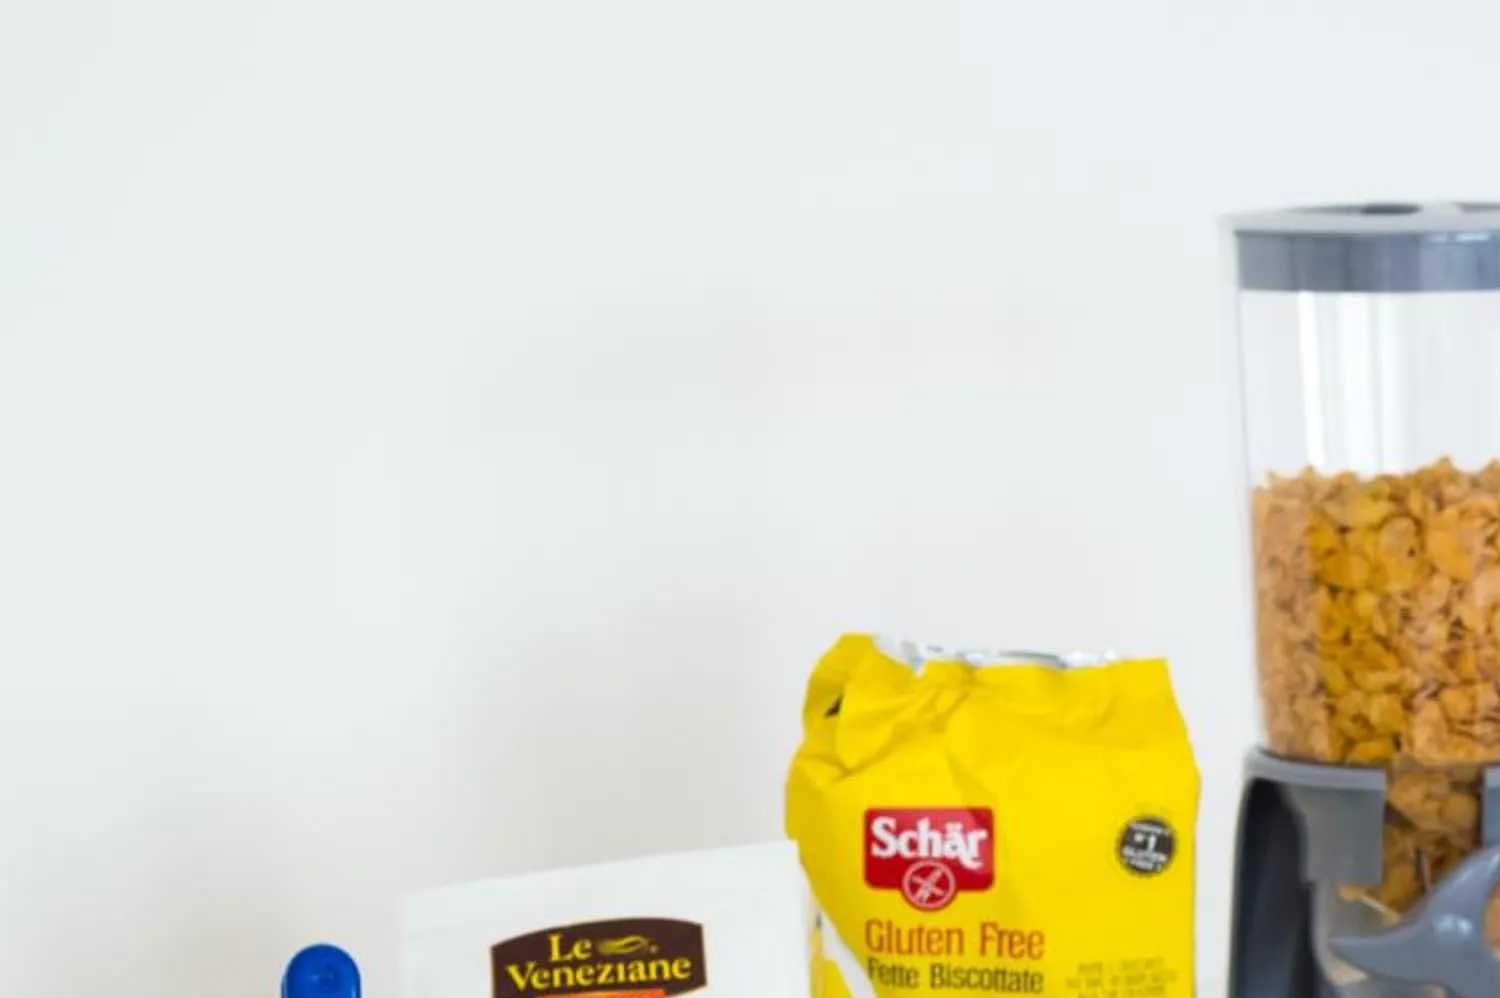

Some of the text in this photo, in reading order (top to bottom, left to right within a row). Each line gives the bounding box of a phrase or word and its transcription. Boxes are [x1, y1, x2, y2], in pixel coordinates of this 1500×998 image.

[870, 816, 988, 869] Schär
[549, 934, 592, 963] Le
[865, 918, 1045, 960] Gluten Free
[506, 957, 692, 991] Veneziane
[868, 959, 919, 989] Fette
[930, 964, 1044, 994] Biscottate
